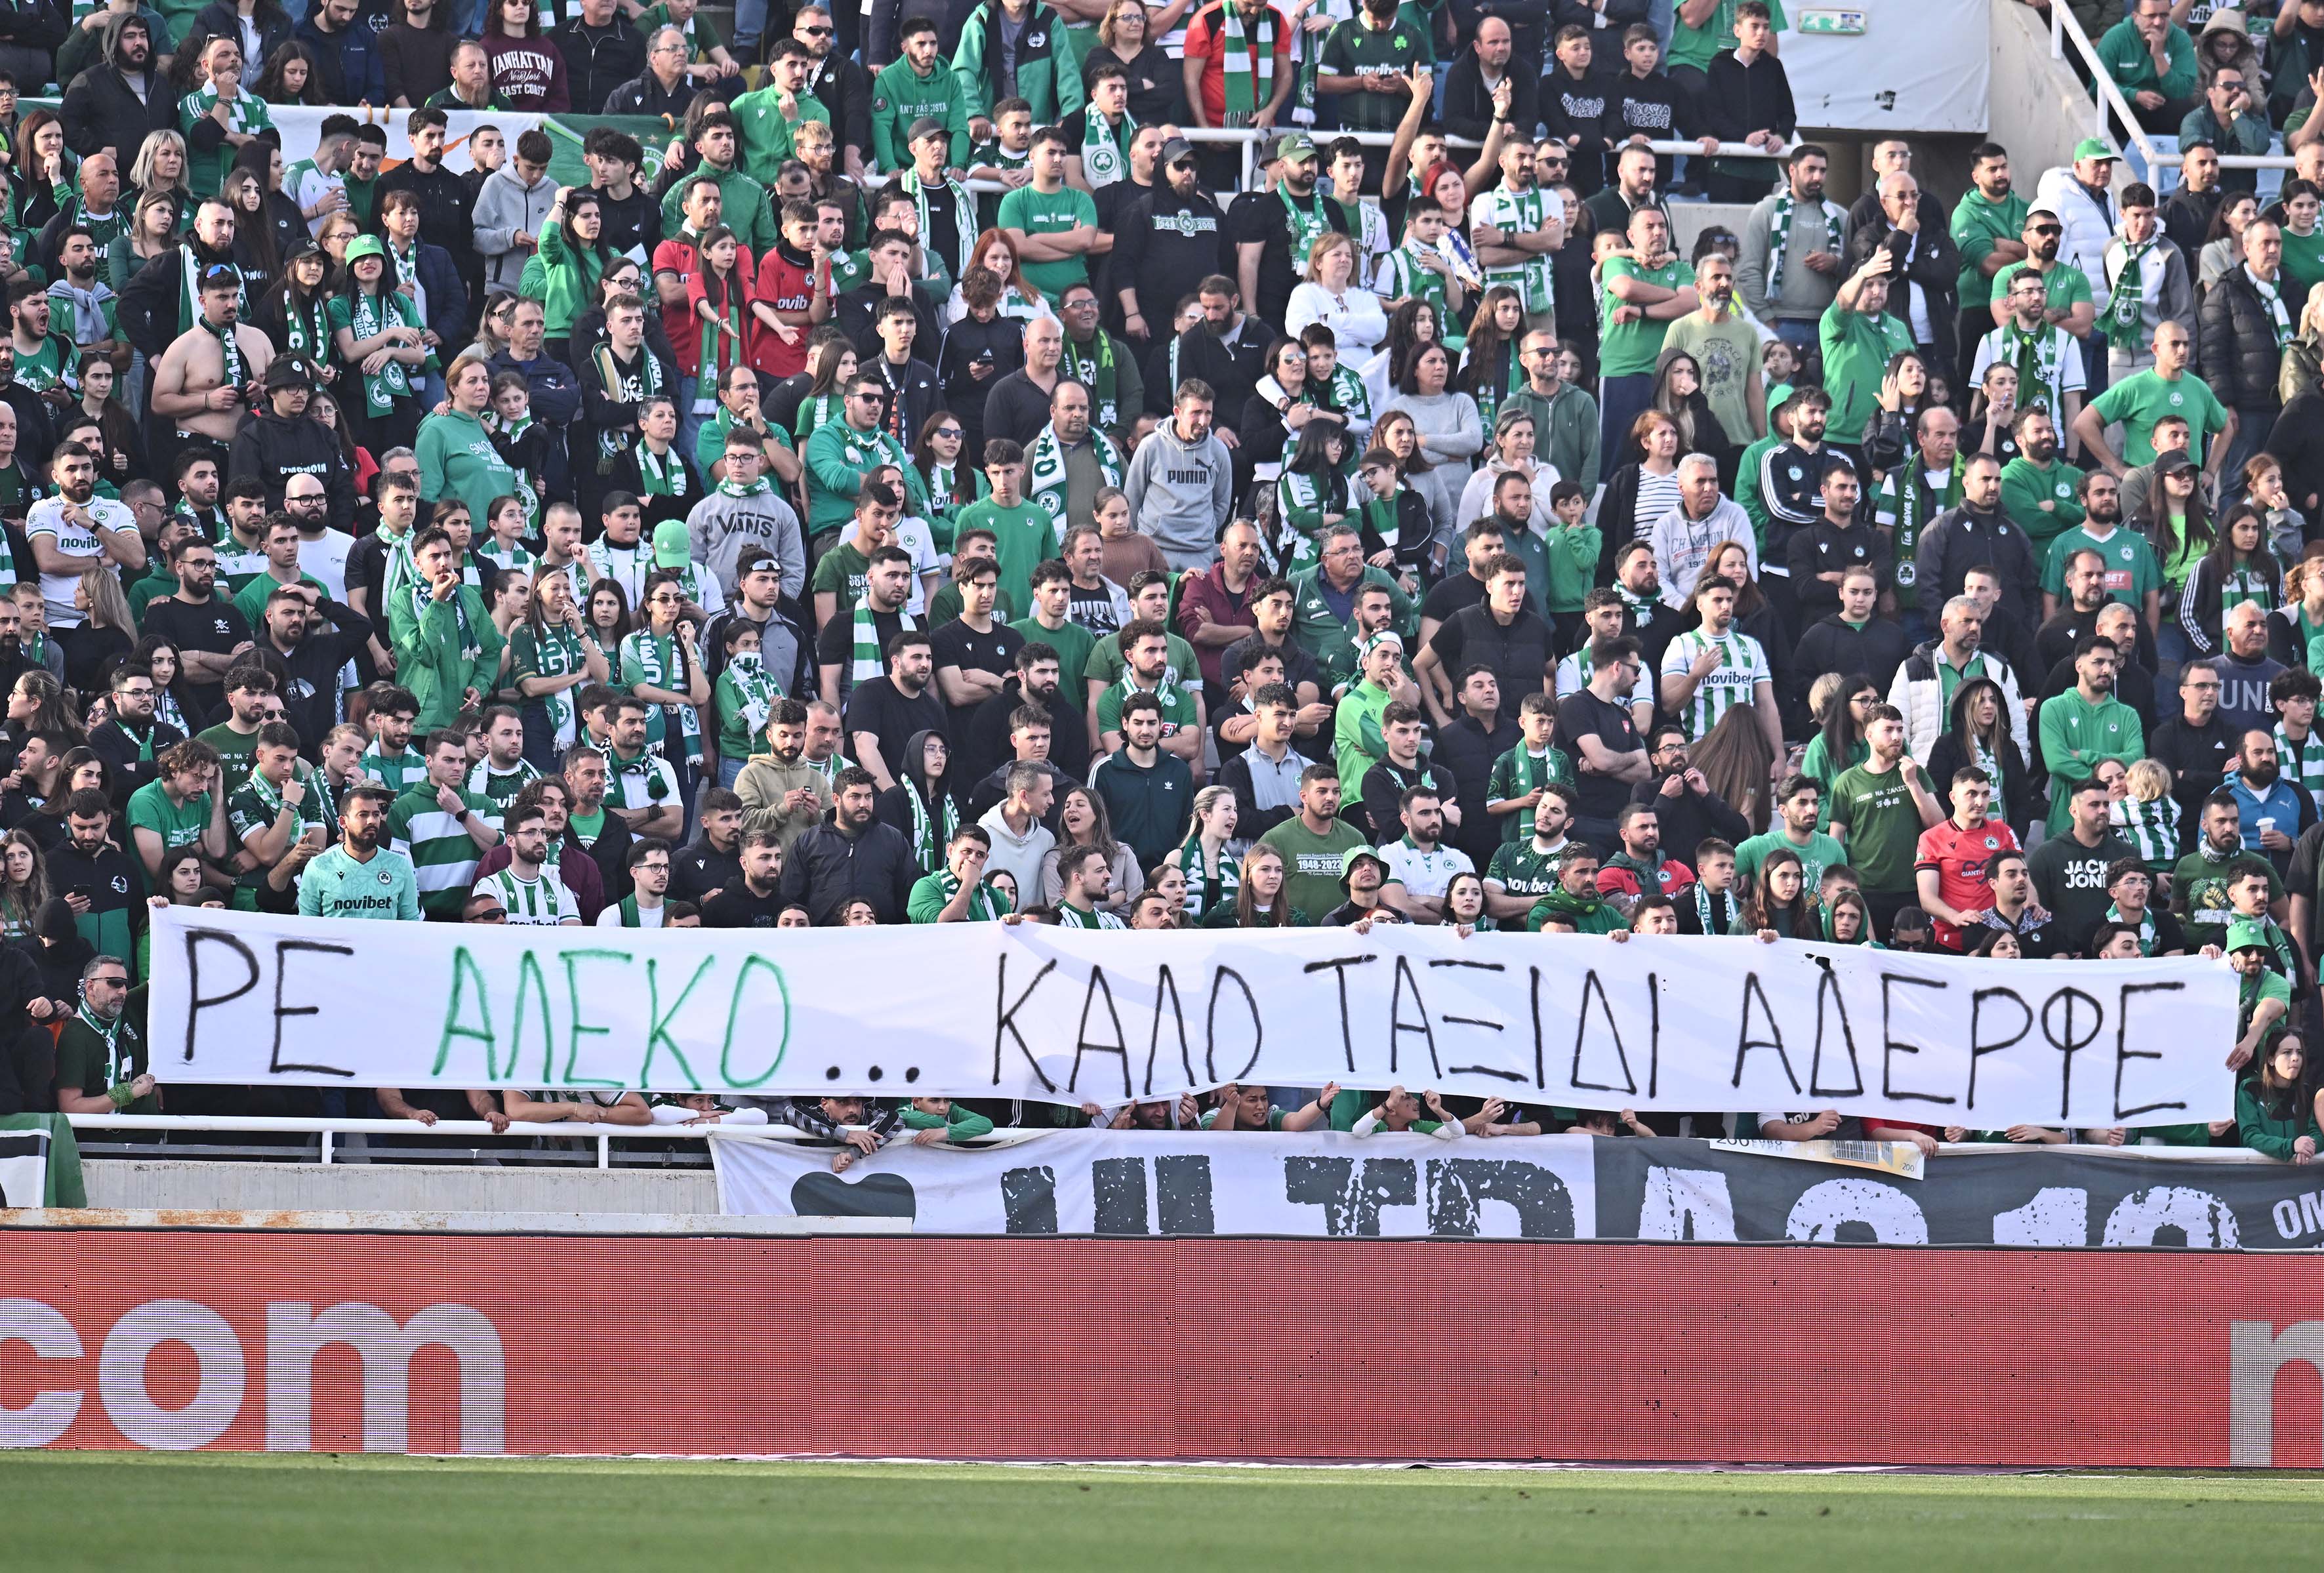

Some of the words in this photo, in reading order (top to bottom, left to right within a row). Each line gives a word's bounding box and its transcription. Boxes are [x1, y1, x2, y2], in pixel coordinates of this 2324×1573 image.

[524, 85, 546, 98] COAST
[1168, 470, 1207, 484] PUMA
[716, 512, 775, 538] VANS
[1702, 670, 1751, 685] novibet
[334, 895, 393, 910] novibet
[992, 952, 1263, 1098] ΚΑΛΟ
[1303, 954, 1660, 1099] ΤΑΞΙΔΙ
[1731, 969, 2187, 1120] ΑΔΕΡΦΕ
[1902, 1162, 1915, 1172] 200
